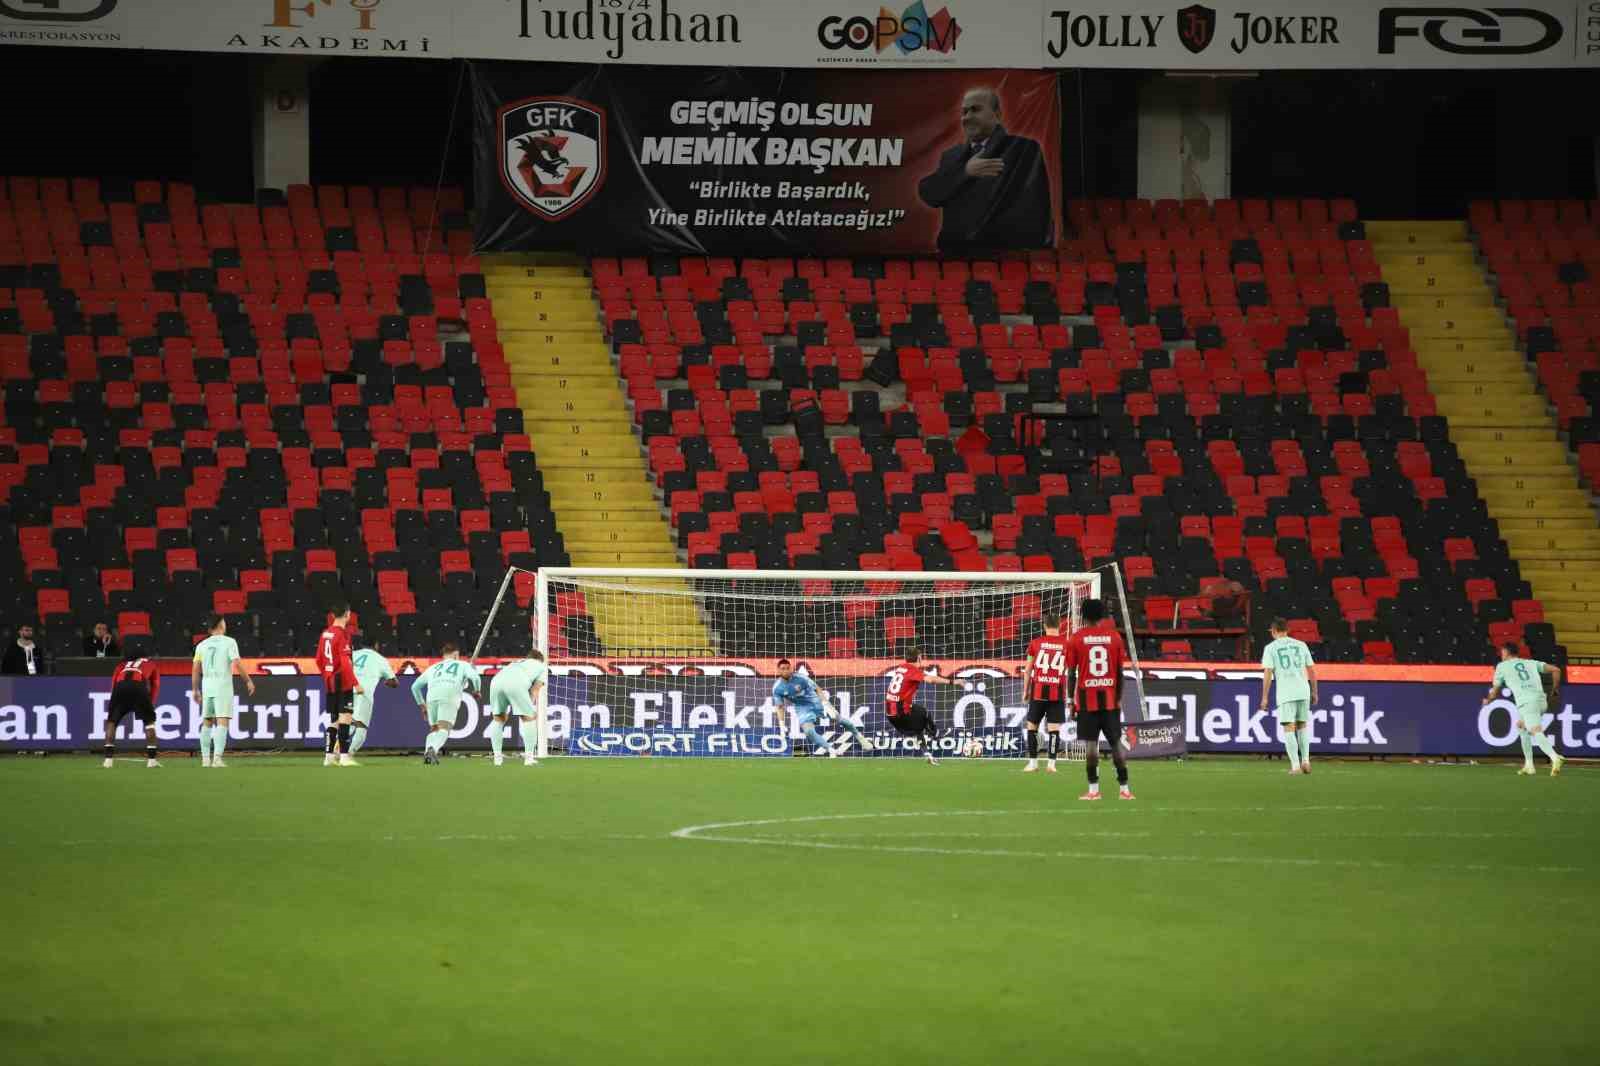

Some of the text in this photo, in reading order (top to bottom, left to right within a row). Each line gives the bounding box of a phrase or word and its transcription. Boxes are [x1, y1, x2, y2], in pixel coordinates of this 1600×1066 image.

[507, 0, 742, 59] Tudyahan
[1047, 10, 1165, 59] JOLLY
[1230, 12, 1341, 54] JOKER
[227, 34, 430, 52] AKADEMİ
[526, 107, 577, 128] GFK
[670, 97, 873, 132] GEÇMİŞ OLSUN
[640, 132, 904, 174] MEMİK BAŞKAN
[777, 182, 870, 201] Başardık,
[648, 208, 689, 226] Yine
[694, 209, 767, 227] Birlikte
[207, 646, 217, 667] 7
[1035, 650, 1065, 676] 44
[1089, 646, 1108, 676] 8
[1277, 645, 1302, 670] 63
[1514, 662, 1530, 681] 8
